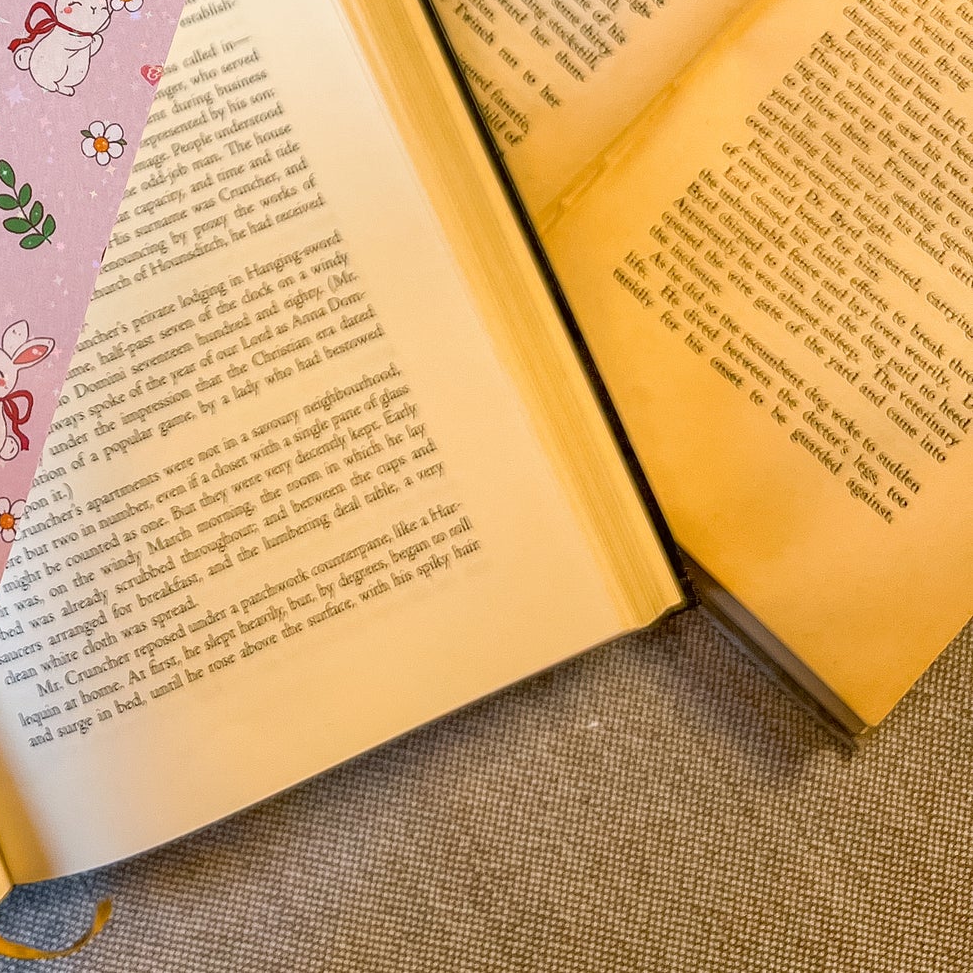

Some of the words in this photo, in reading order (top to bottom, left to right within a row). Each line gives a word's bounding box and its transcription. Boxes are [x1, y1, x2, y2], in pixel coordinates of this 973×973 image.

[131, 303, 176, 329] private
[176, 278, 229, 309] lodging
[227, 274, 246, 288] in
[244, 228, 344, 281] Hanging-sword
[27, 726, 55, 748] and
[56, 716, 93, 738] surge
[91, 708, 113, 723] in
[113, 690, 148, 715] bed,
[147, 672, 184, 700] until
[183, 668, 204, 684] he
[207, 653, 236, 674] rose
[238, 634, 278, 659] above
[280, 621, 304, 640] the
[306, 599, 358, 628] surface,
[357, 578, 392, 603] with
[389, 570, 415, 588] his
[415, 552, 453, 579] spiky
[450, 539, 482, 560] hair
[35, 678, 65, 698] Mr.
[64, 652, 132, 686] Cruncher
[133, 622, 188, 659] reposed
[187, 608, 228, 634] under
[228, 603, 240, 615] a
[239, 567, 311, 615] patchwork
[310, 533, 394, 577] counterpane,
[391, 520, 418, 539] like
[418, 516, 431, 527] a
[428, 502, 464, 523] Har-
